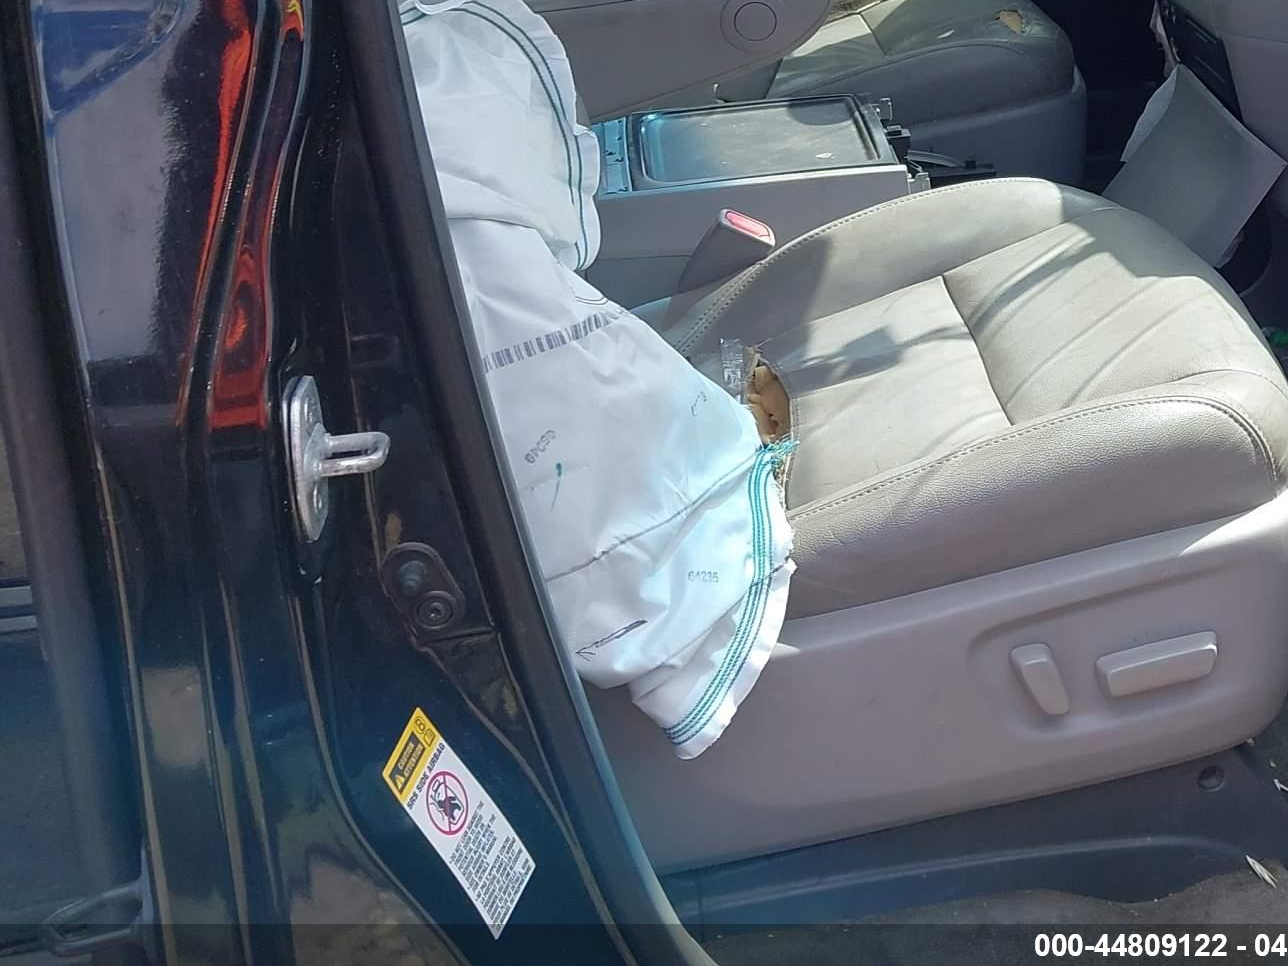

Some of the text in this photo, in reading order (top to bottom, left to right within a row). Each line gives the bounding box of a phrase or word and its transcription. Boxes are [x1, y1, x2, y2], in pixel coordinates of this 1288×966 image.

[406, 740, 445, 811] SRS SIDE AIRBAG
